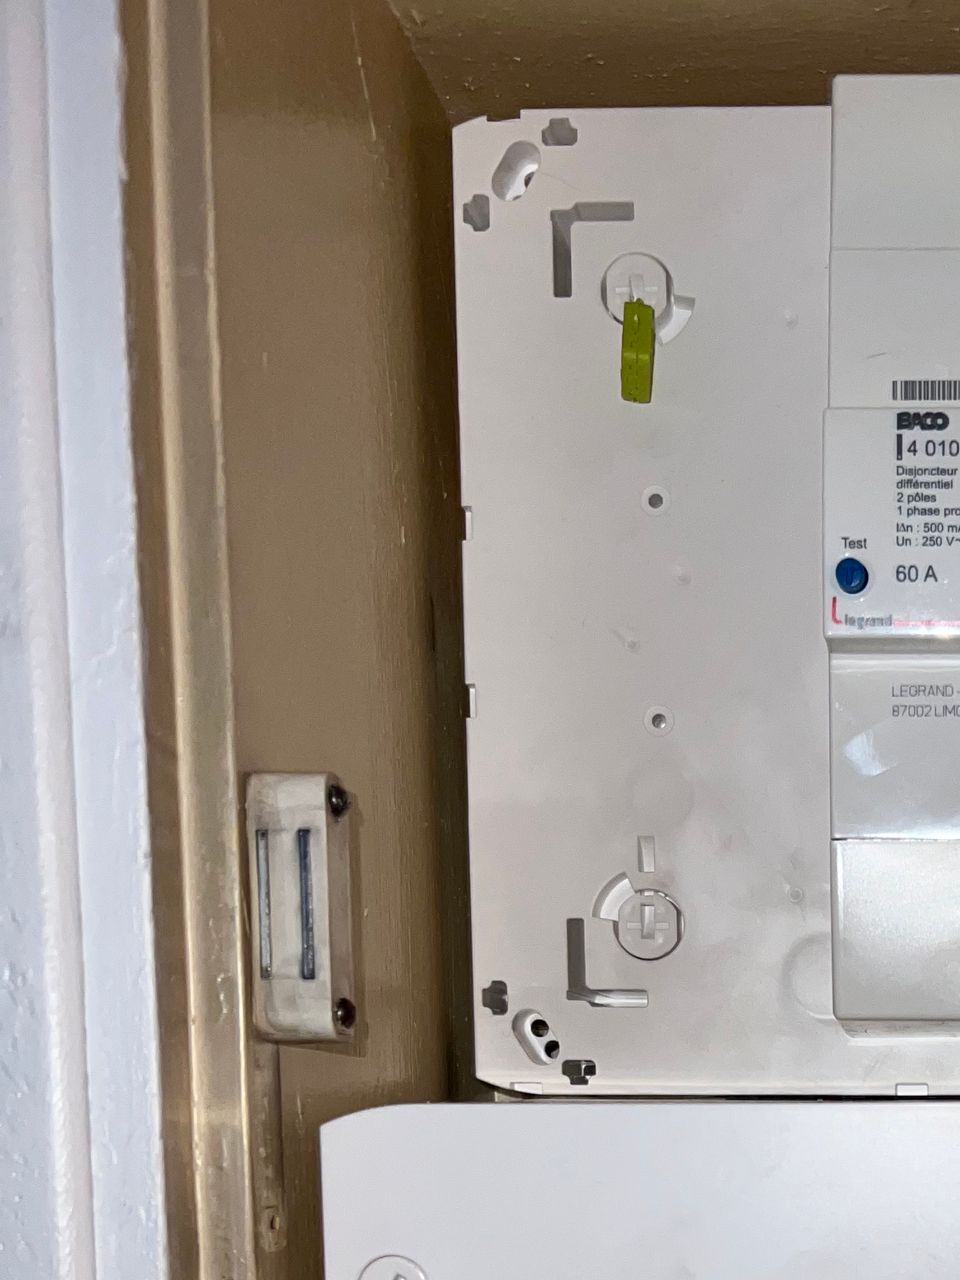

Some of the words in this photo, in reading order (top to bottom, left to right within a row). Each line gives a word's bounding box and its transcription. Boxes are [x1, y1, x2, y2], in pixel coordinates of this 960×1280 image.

[896, 412, 949, 430] BACO
[907, 440, 918, 456] 4
[925, 440, 960, 456] 010
[896, 466, 958, 478] Disjoncteur
[896, 479, 953, 489] différentiel
[897, 493, 904, 502] 2
[907, 491, 937, 505] pôles
[897, 506, 902, 516] 1
[907, 506, 940, 519] phase
[923, 523, 944, 533] 500
[841, 537, 868, 549] Test
[896, 536, 912, 547] Un
[922, 536, 942, 547] 250
[895, 565, 918, 582] 60
[923, 565, 938, 582] A
[844, 614, 893, 629] legrand
[892, 684, 953, 697] LEGRAND
[892, 705, 932, 717] 87002
